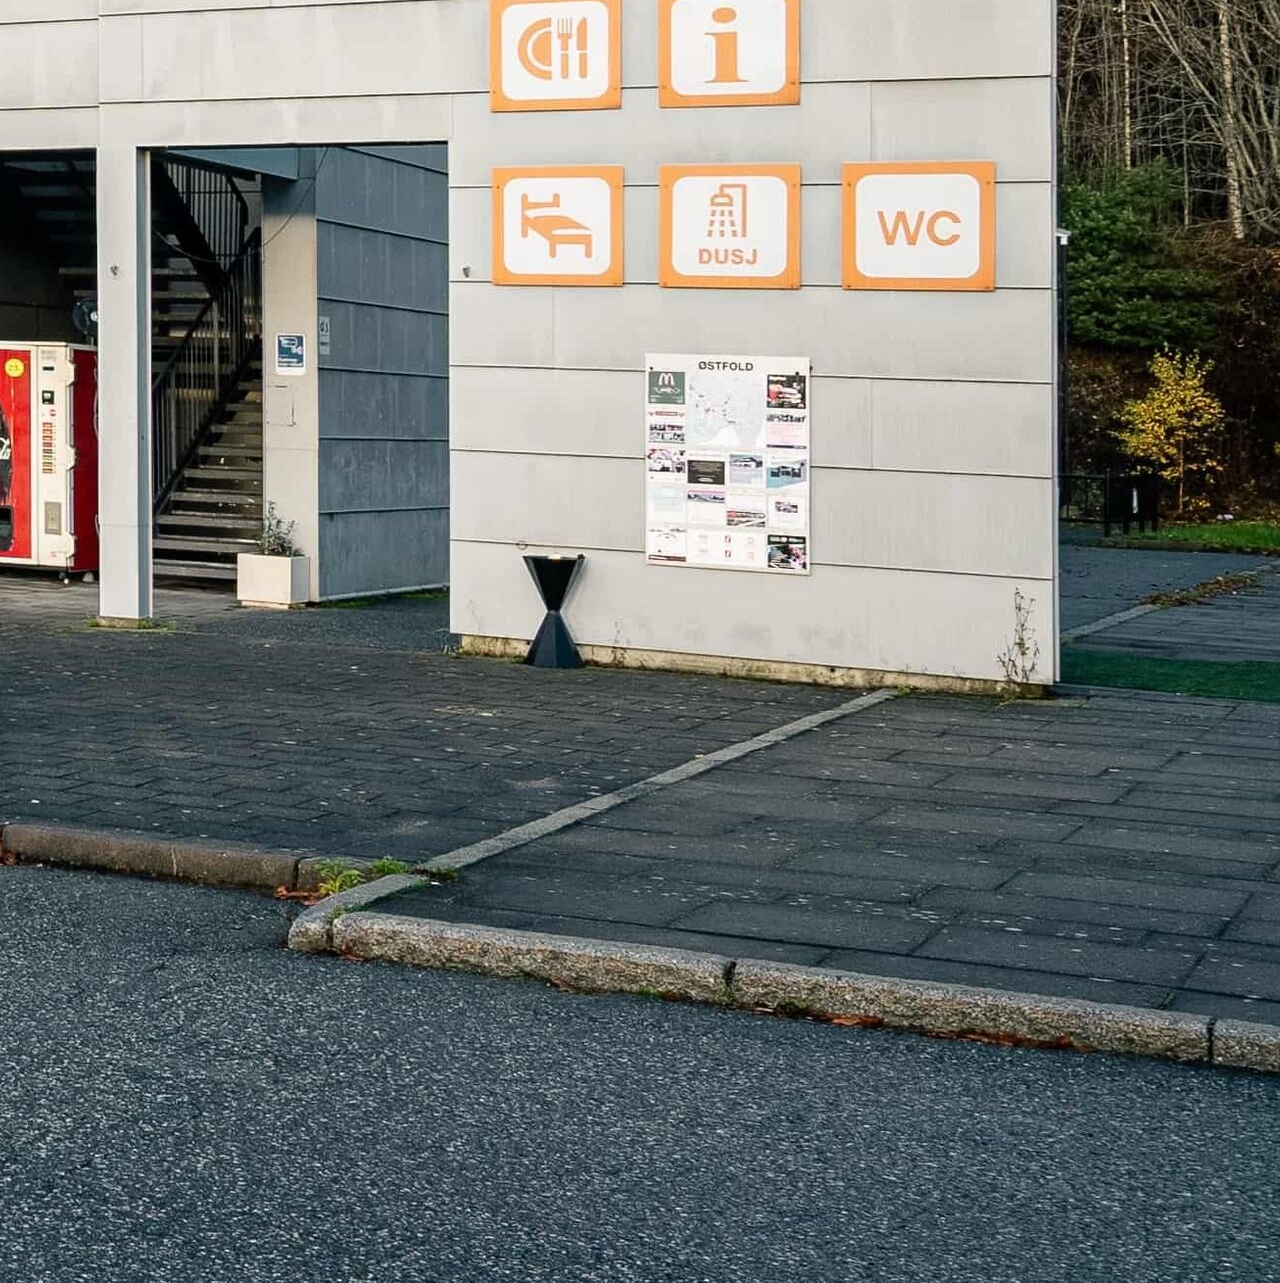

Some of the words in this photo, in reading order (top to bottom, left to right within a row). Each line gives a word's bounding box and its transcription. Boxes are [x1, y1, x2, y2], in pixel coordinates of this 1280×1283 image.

[877, 210, 961, 246] WC
[698, 248, 757, 265] DUSJ
[698, 361, 754, 371] ØSTFOLD
